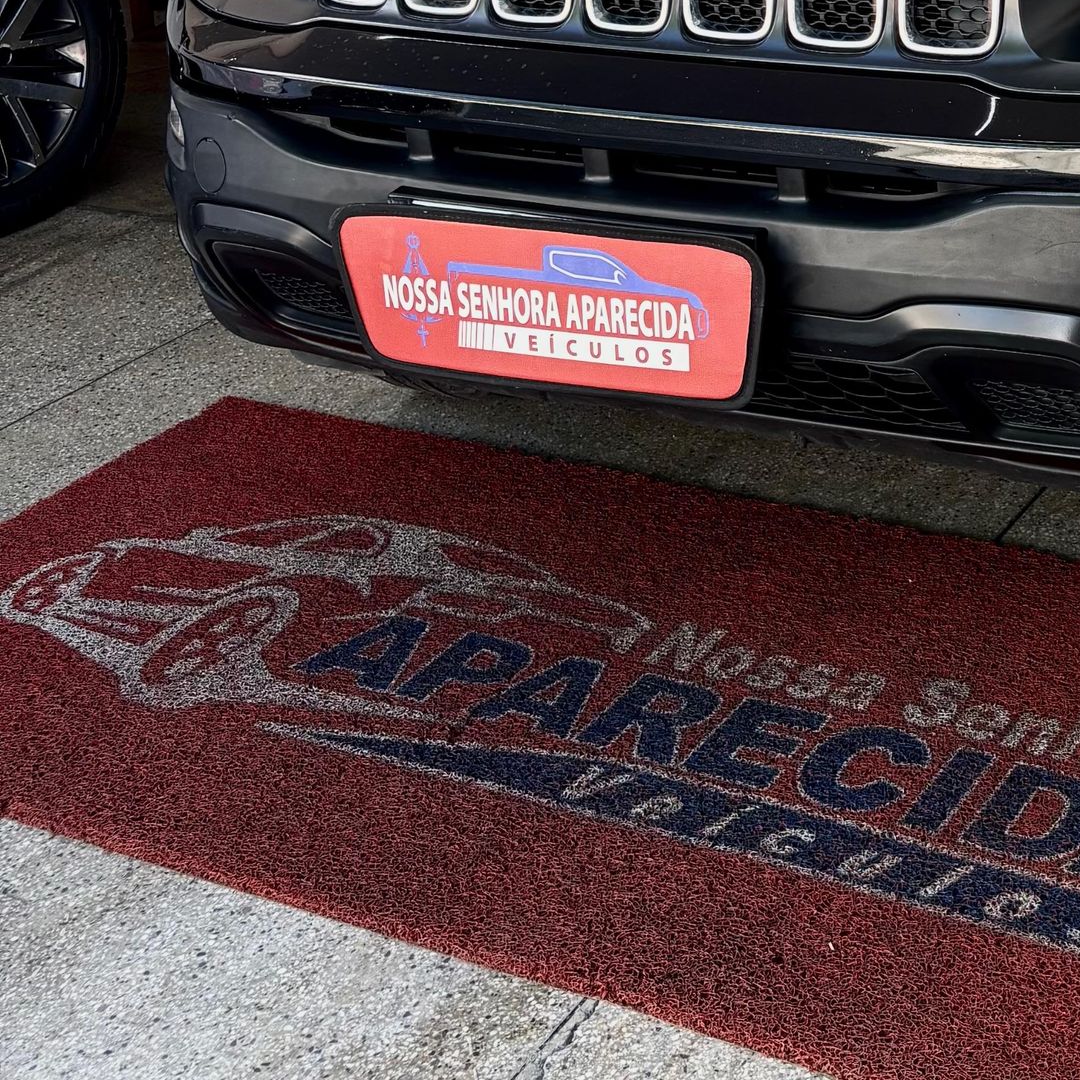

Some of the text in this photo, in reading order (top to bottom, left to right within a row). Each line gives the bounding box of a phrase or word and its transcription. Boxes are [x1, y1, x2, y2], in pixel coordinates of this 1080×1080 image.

[382, 274, 695, 340] NOSSA SENHORA APARECIDA
[504, 332, 673, 366] VEÍCULOS
[643, 621, 888, 711] Nossa
